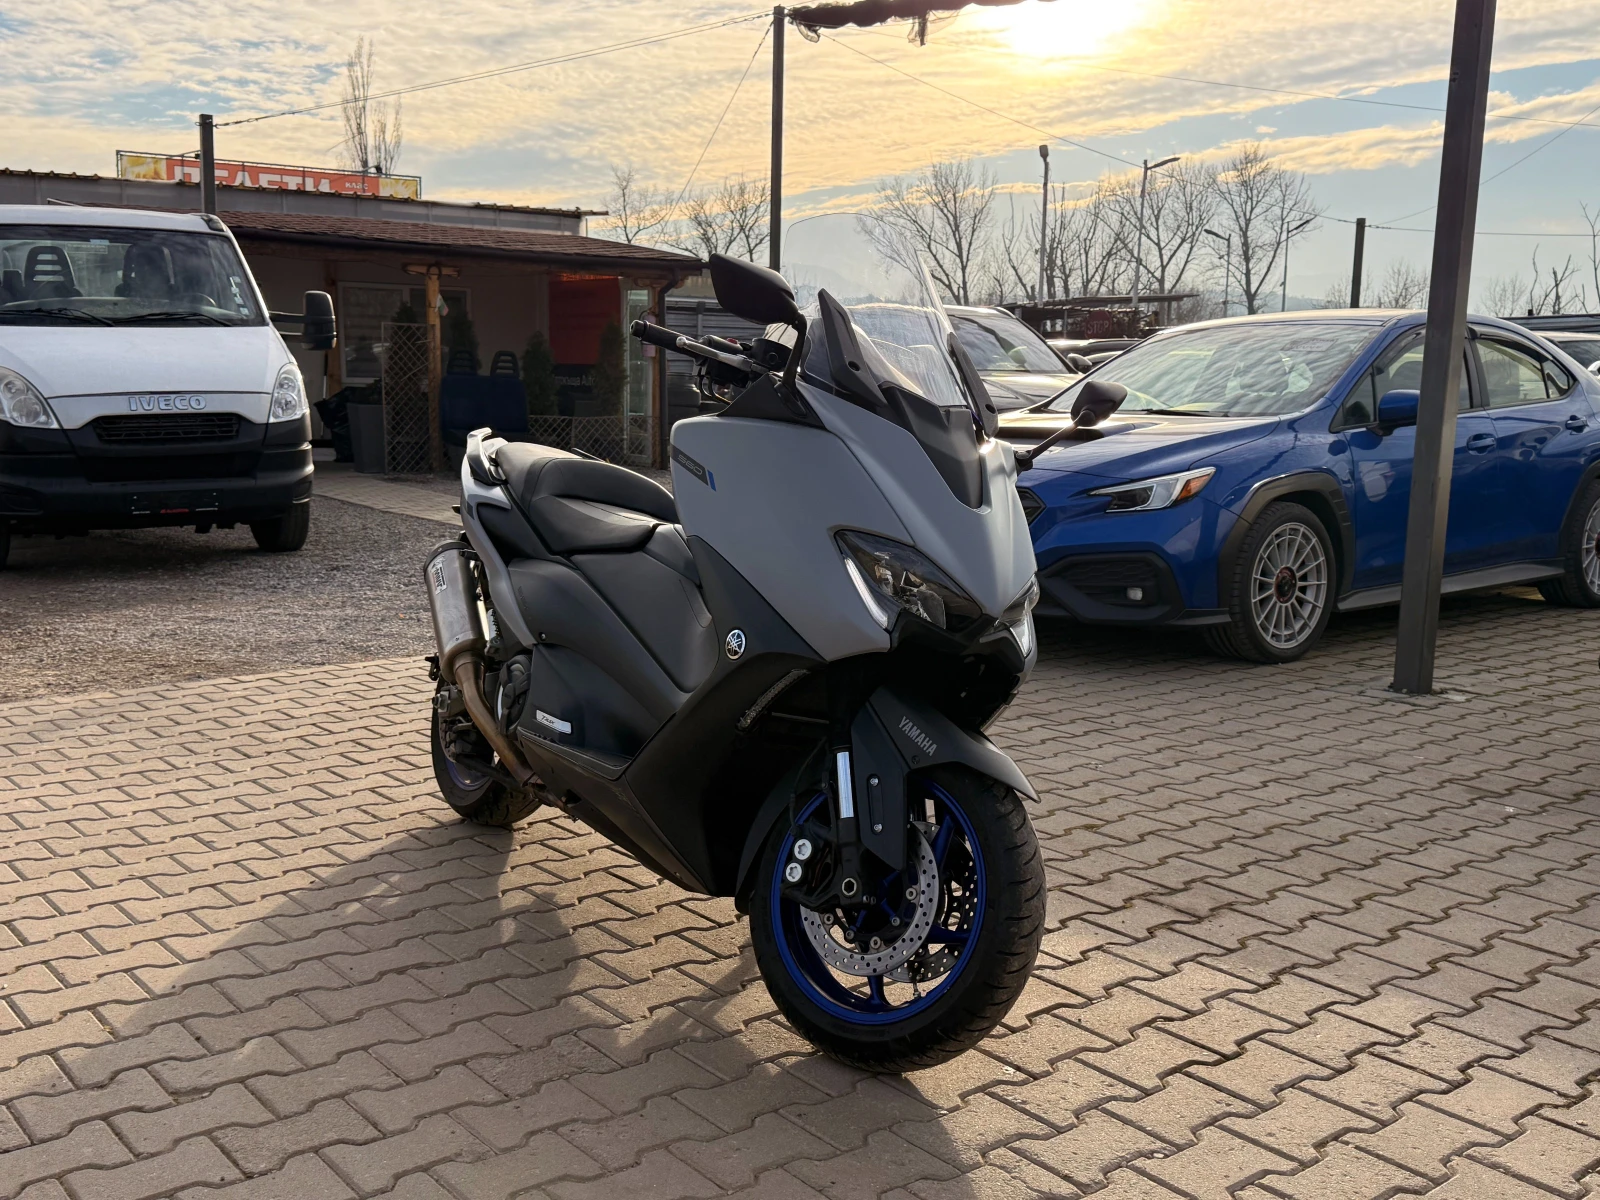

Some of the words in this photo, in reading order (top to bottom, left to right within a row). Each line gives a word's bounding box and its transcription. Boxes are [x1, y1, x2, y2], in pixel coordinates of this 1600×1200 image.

[1087, 320, 1110, 335] STOP
[128, 394, 207, 412] IVECO
[898, 715, 938, 757] YAMAHA
